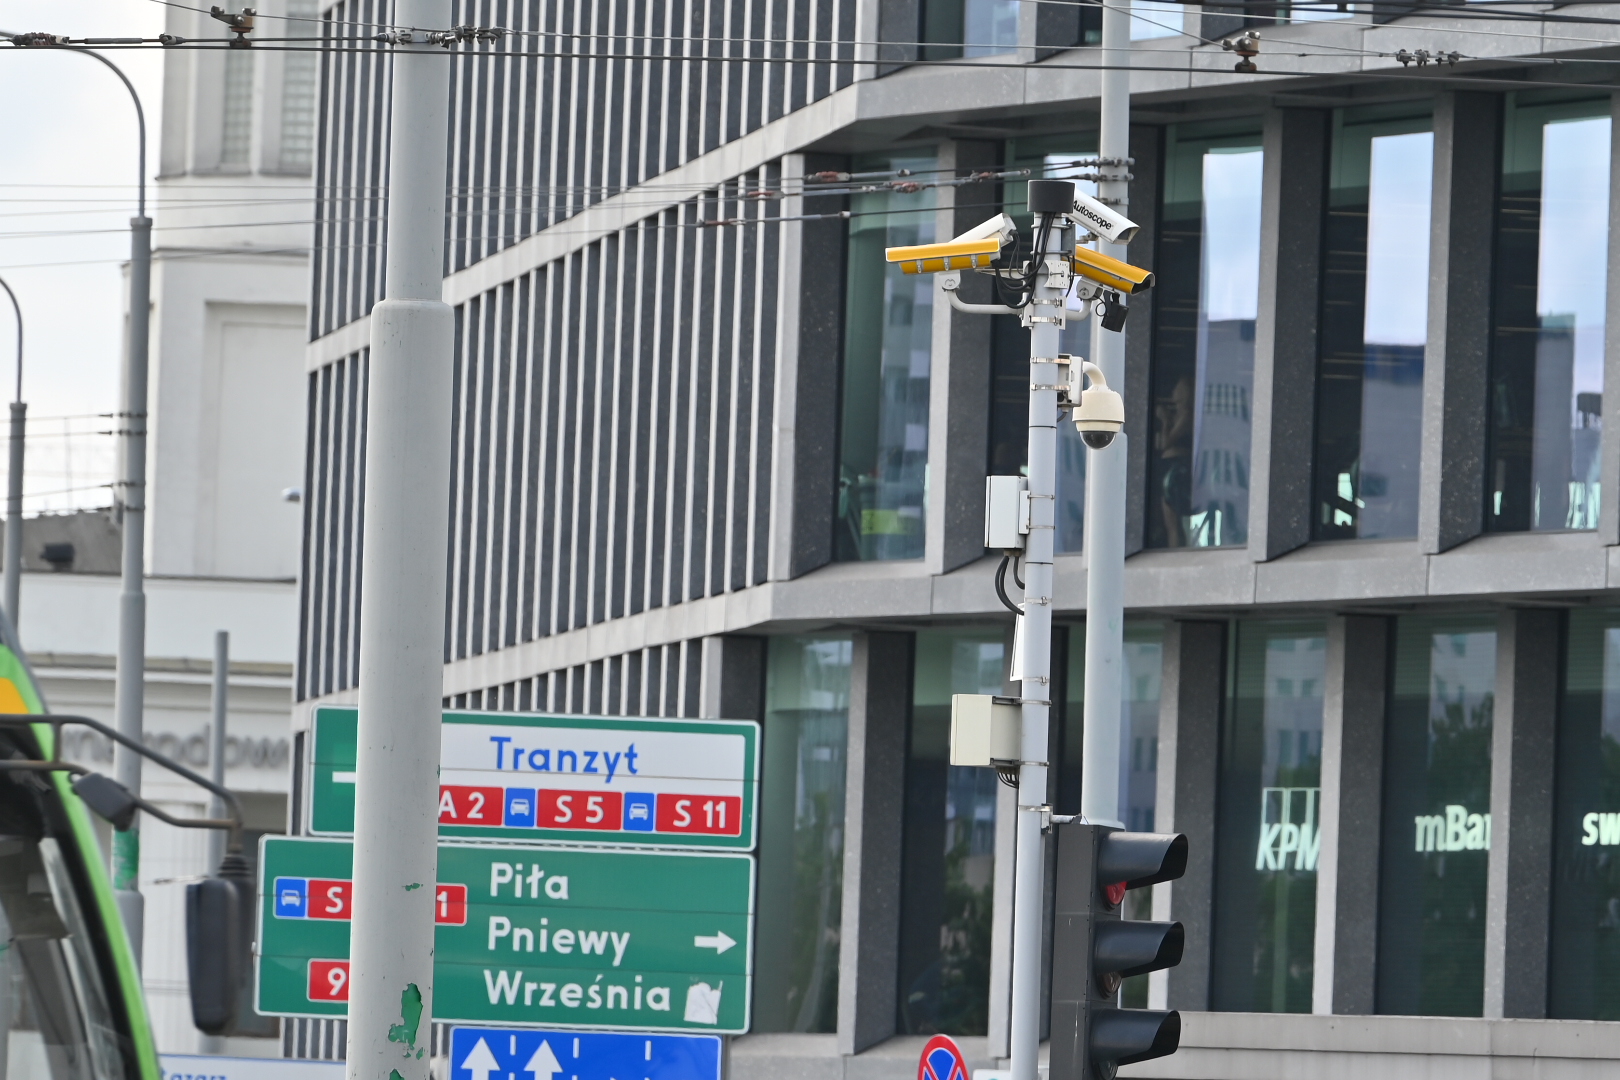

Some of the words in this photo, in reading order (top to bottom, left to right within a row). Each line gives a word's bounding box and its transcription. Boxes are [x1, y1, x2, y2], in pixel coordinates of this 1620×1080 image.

[489, 737, 640, 782] Tranzyt
[438, 790, 458, 819] A
[467, 791, 485, 819] 2
[554, 795, 573, 823] S
[586, 796, 604, 824] 5
[674, 800, 691, 828] S
[703, 801, 727, 829] 11
[490, 862, 570, 900] Piła
[488, 915, 631, 967] Pniewy
[484, 969, 671, 1012] Września
